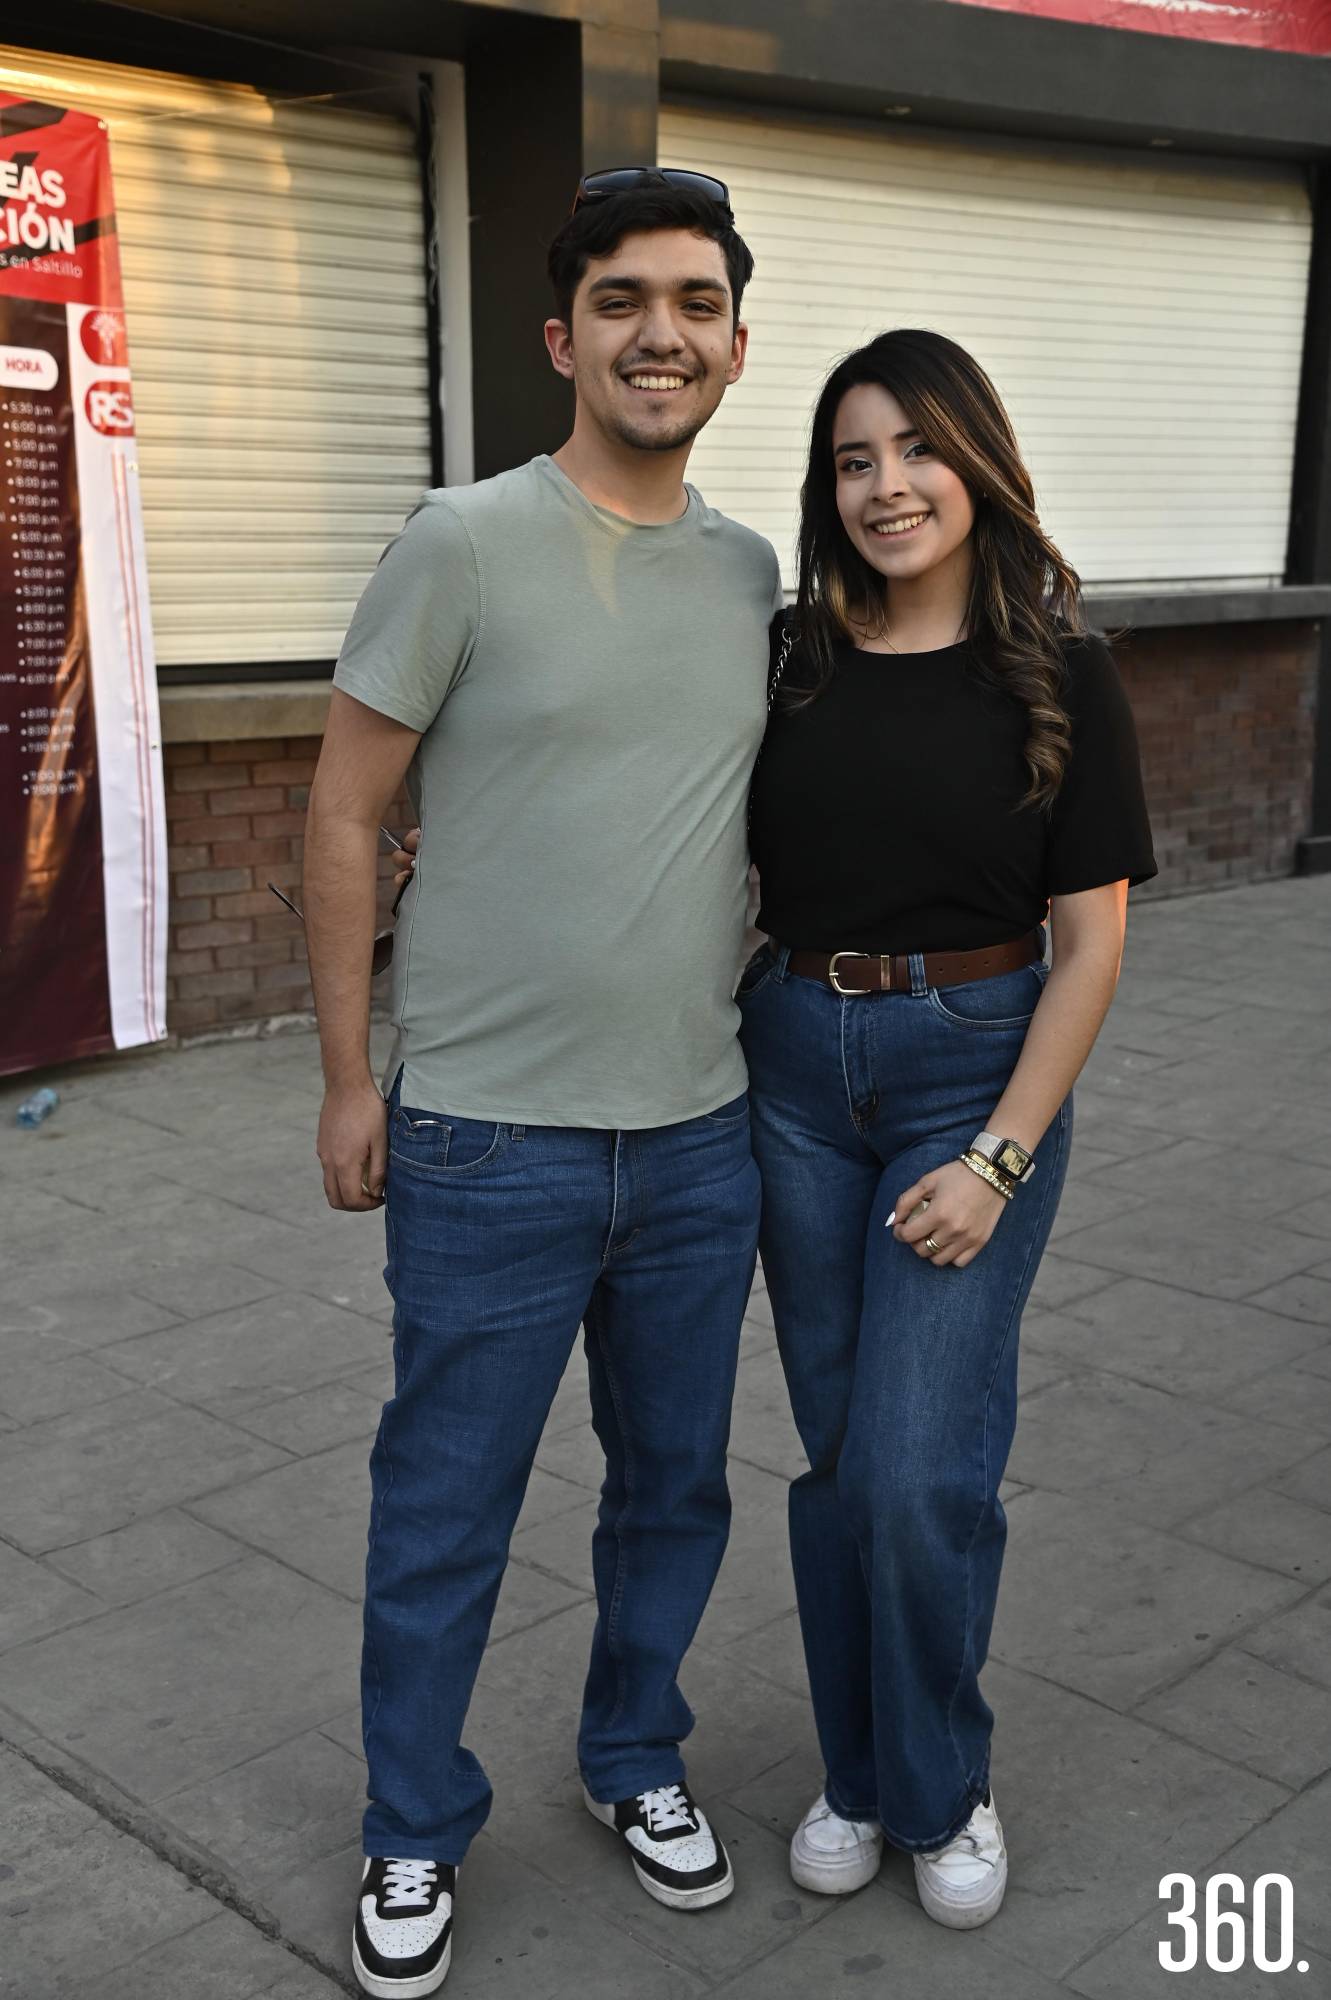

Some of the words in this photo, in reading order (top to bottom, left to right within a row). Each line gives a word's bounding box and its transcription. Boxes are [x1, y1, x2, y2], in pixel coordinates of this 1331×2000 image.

[0, 160, 67, 209] EAS
[10, 255, 29, 269] en
[32, 256, 83, 278] Saltillo
[6, 358, 43, 374] HORA
